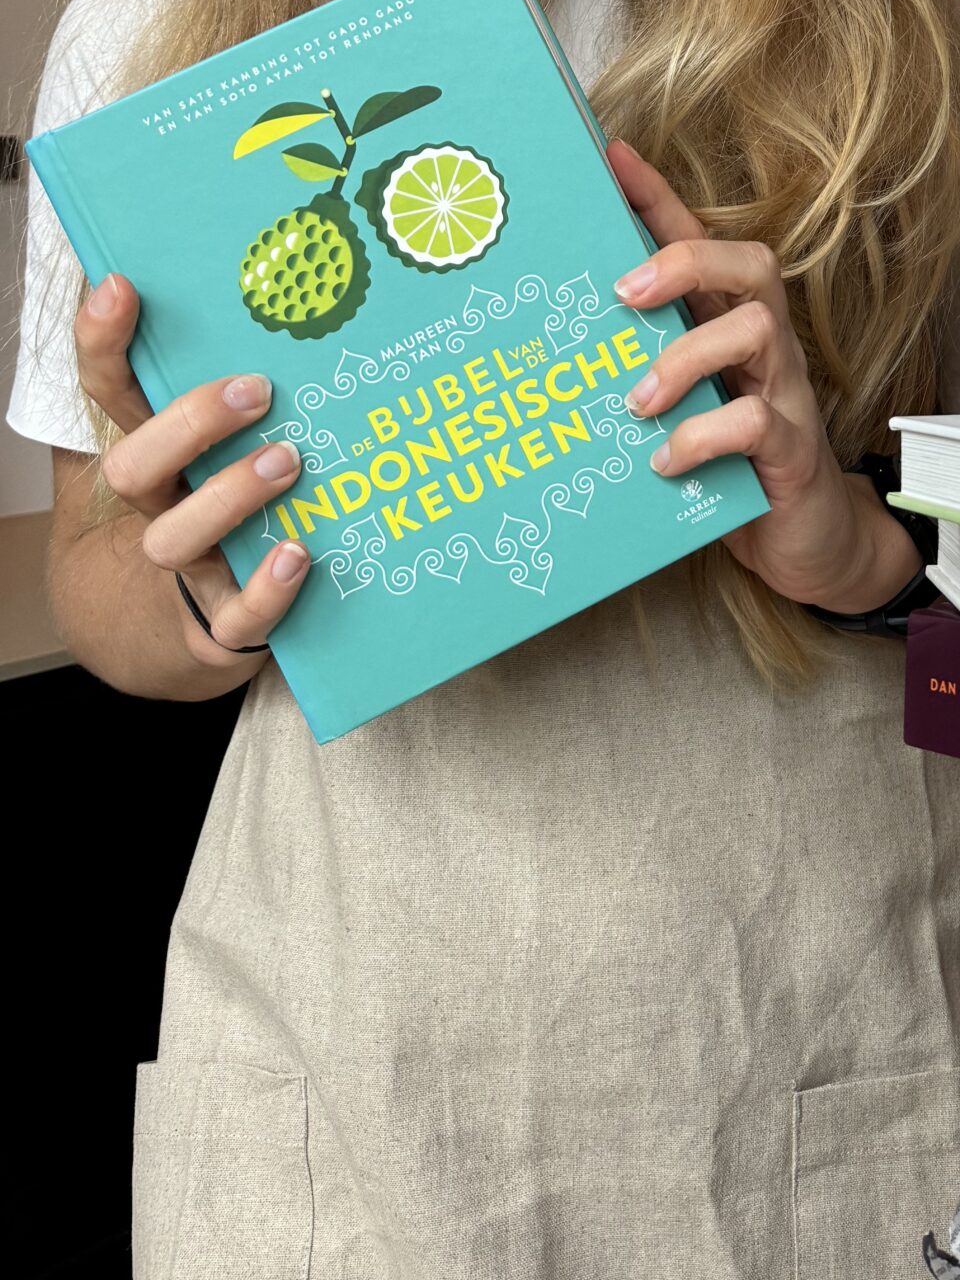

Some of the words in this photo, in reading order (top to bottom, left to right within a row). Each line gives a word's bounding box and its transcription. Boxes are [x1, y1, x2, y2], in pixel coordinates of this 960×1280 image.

[142, 106, 173, 127] VAN
[178, 87, 215, 111] SATE
[219, 53, 289, 91] KAMBING
[294, 37, 322, 56] TOT
[328, 16, 369, 41] GADO
[158, 120, 178, 136] EN
[184, 103, 214, 123] VAN
[219, 82, 259, 107] SOTO
[265, 61, 305, 86] AYAM
[309, 45, 338, 65] TOT
[343, 10, 415, 49] RENDANG
[379, 314, 459, 362] MAUREEN
[408, 343, 442, 366] TAN
[508, 335, 545, 360] VAN
[525, 349, 551, 371] DE
[350, 437, 376, 458] DE
[366, 348, 525, 446] BIJBEL
[273, 325, 651, 541] INDONESISCHE
[380, 409, 593, 542] KEUKEN
[676, 493, 724, 522] CARRERA
[690, 505, 718, 525] culinair
[930, 678, 957, 696] DAN
